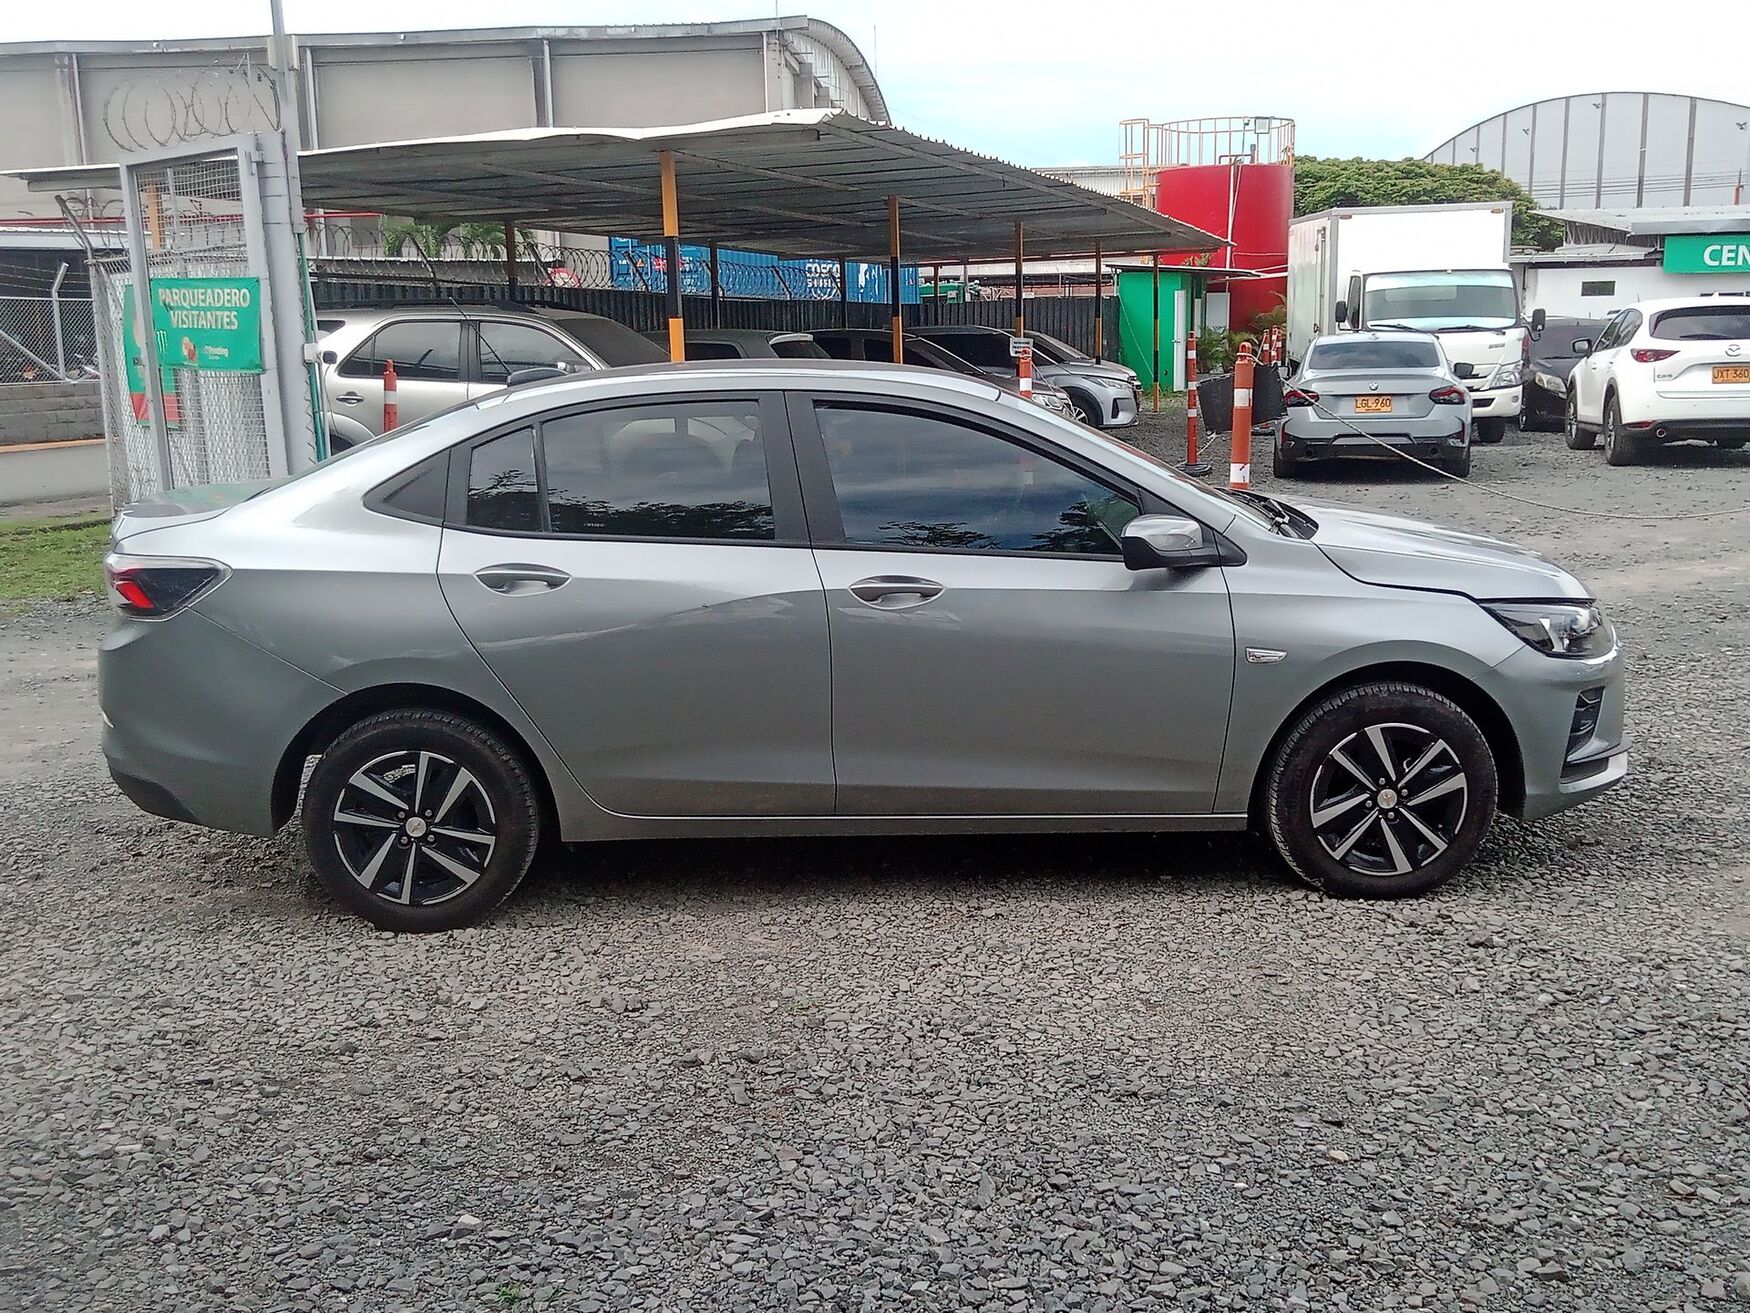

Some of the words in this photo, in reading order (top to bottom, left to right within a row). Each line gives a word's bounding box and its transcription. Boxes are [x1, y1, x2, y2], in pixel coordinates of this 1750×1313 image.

[1703, 244, 1750, 267] CEN
[158, 288, 251, 308] PARQUEADERO
[170, 310, 239, 330] VISITANTES
